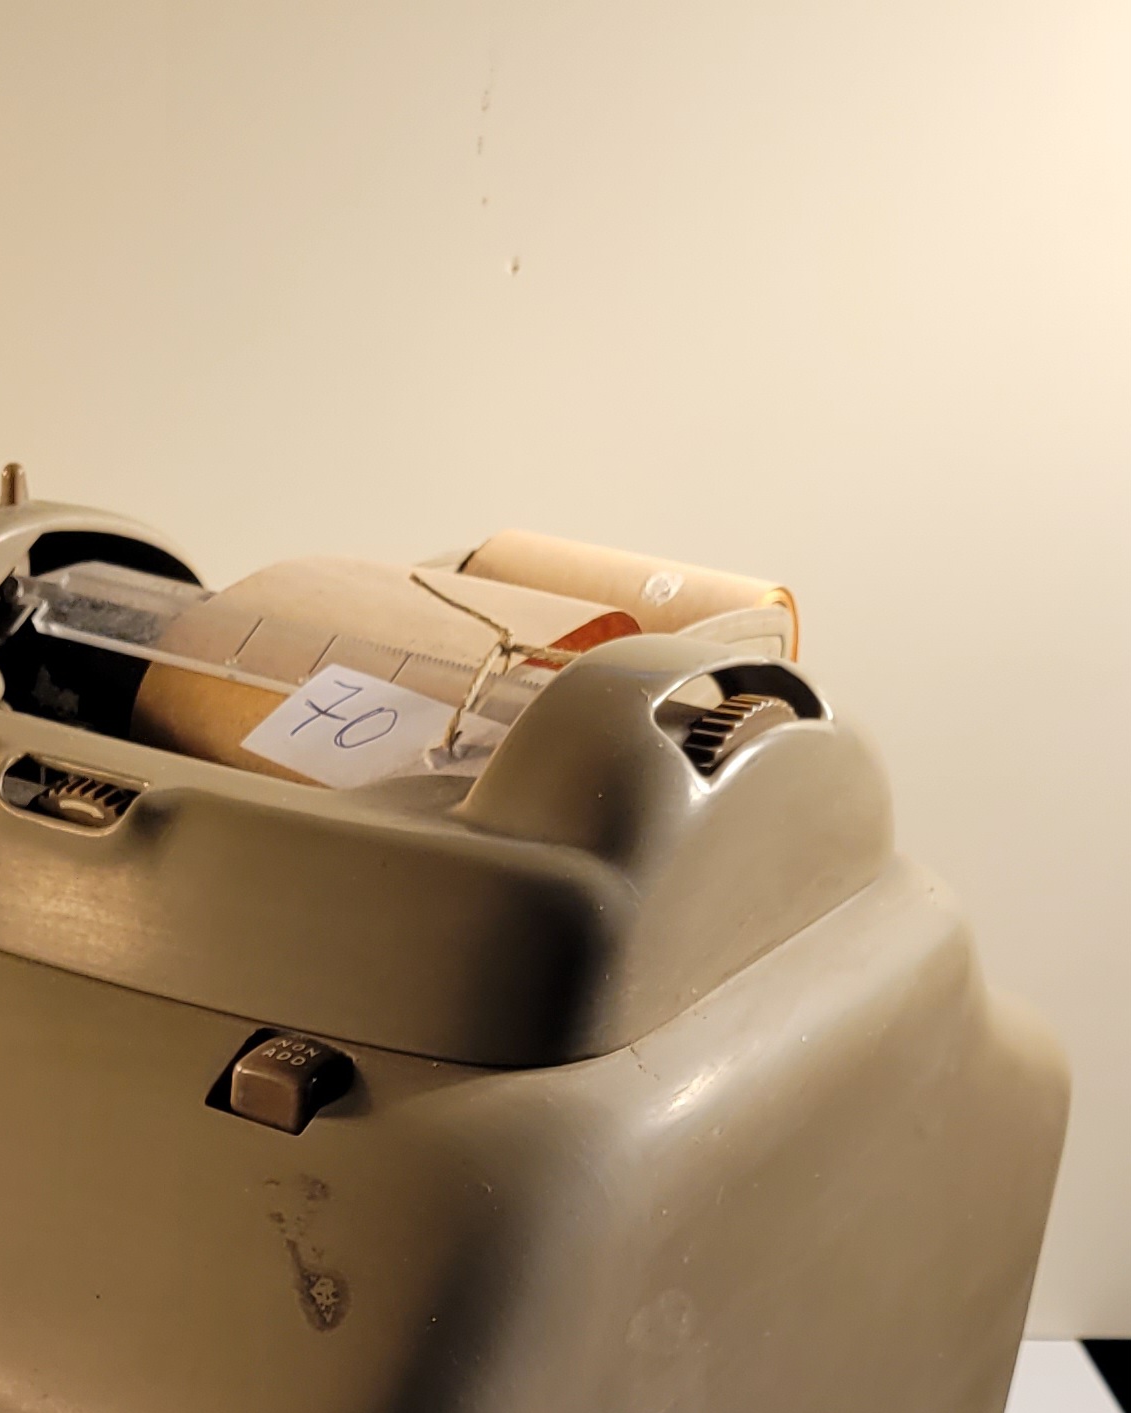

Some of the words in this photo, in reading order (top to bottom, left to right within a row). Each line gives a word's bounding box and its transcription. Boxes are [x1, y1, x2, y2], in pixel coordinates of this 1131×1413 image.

[289, 679, 398, 749] 70
[262, 1048, 306, 1066] ADD
[275, 1039, 320, 1058] NON
